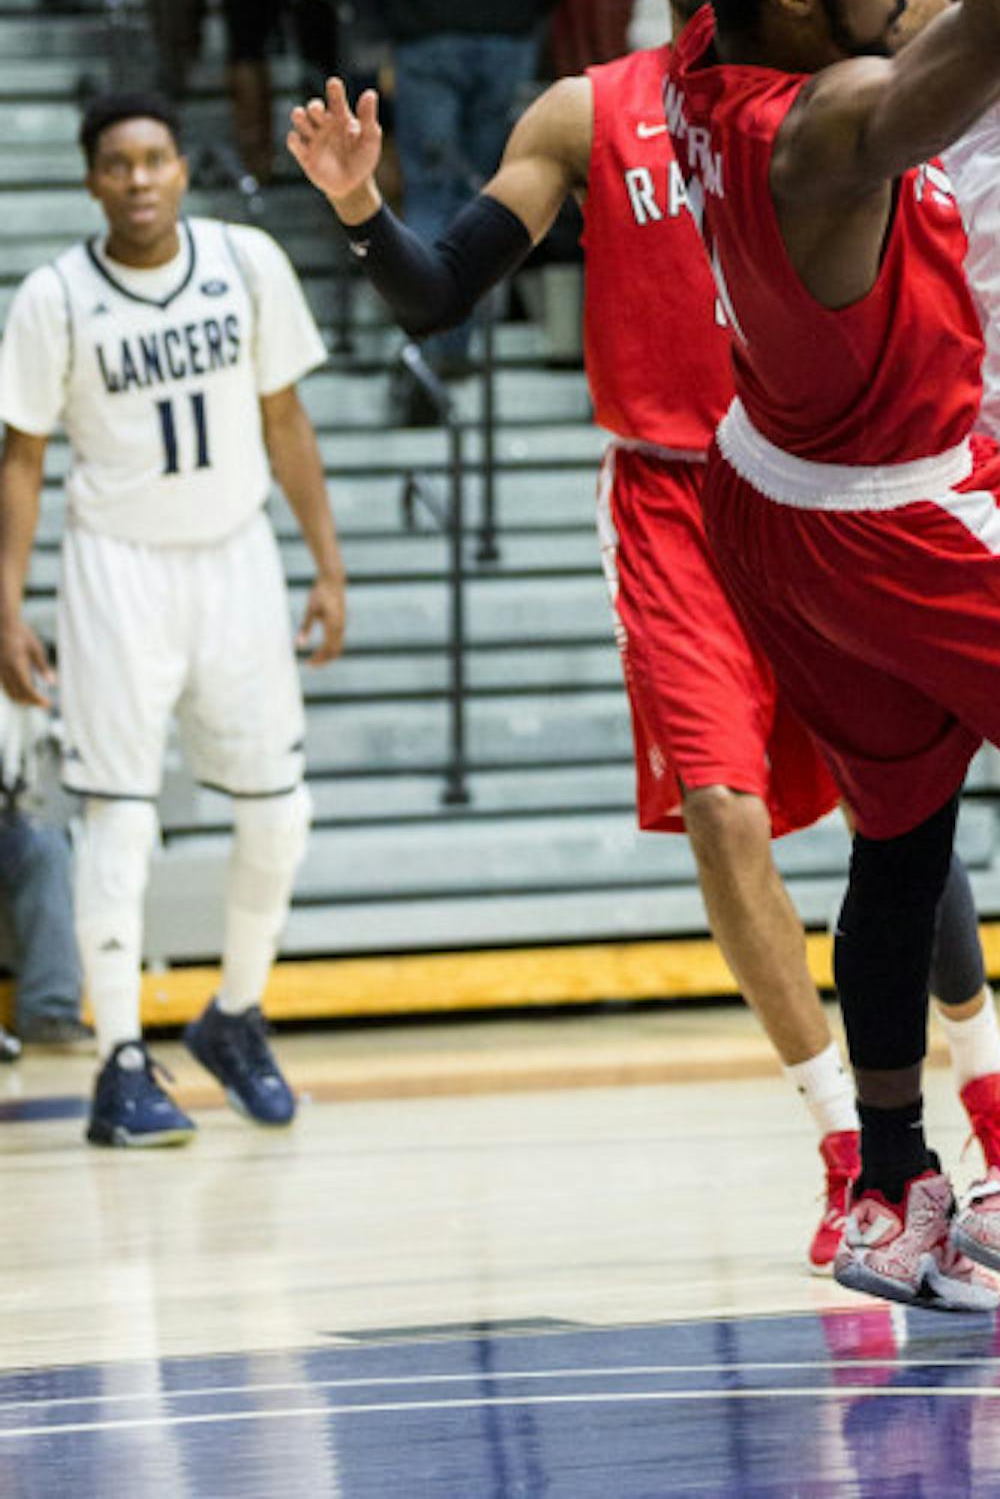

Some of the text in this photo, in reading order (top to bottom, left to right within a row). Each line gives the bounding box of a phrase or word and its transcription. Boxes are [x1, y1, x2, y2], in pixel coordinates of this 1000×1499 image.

[624, 159, 690, 225] RA
[96, 313, 241, 393] LANCERS
[157, 393, 210, 474] 11
